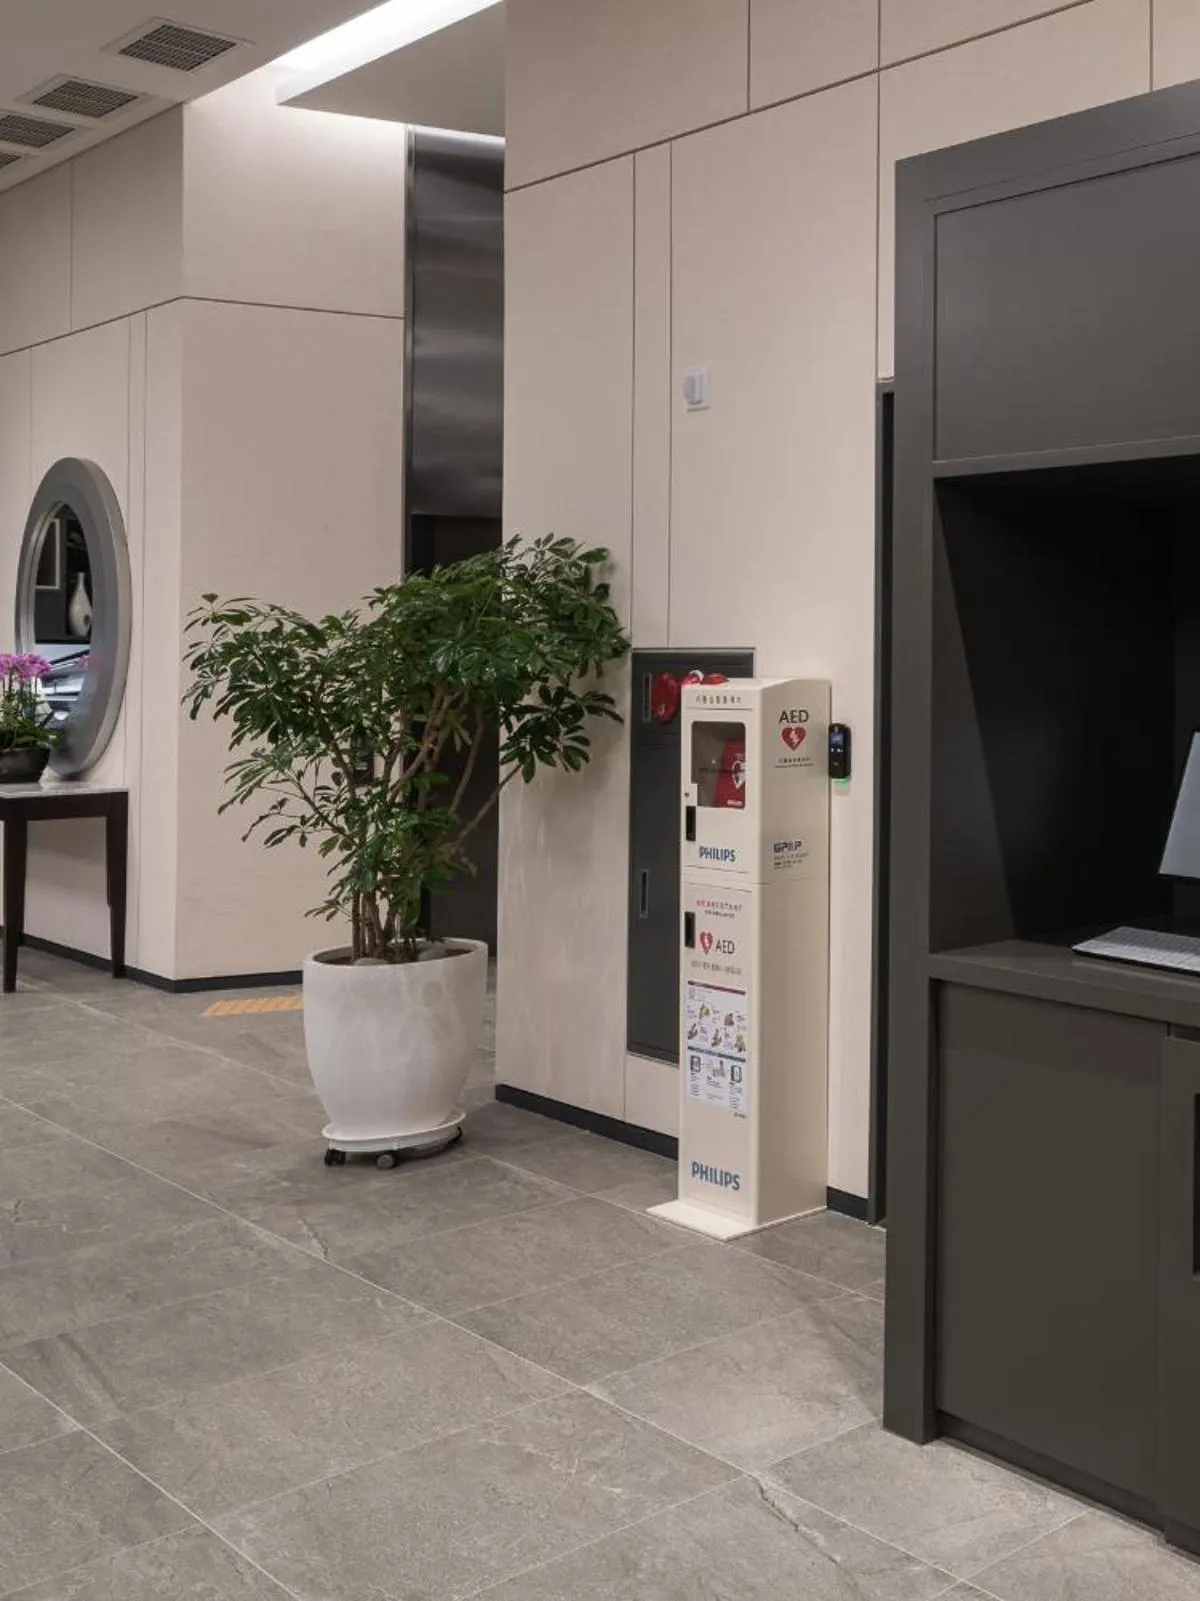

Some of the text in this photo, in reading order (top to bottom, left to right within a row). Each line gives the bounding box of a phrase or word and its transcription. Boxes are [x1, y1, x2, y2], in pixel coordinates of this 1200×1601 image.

[778, 709, 809, 724] AED
[699, 846, 736, 862] PHILIPS
[715, 939, 735, 954] AED
[691, 1161, 740, 1192] PHILIPS
